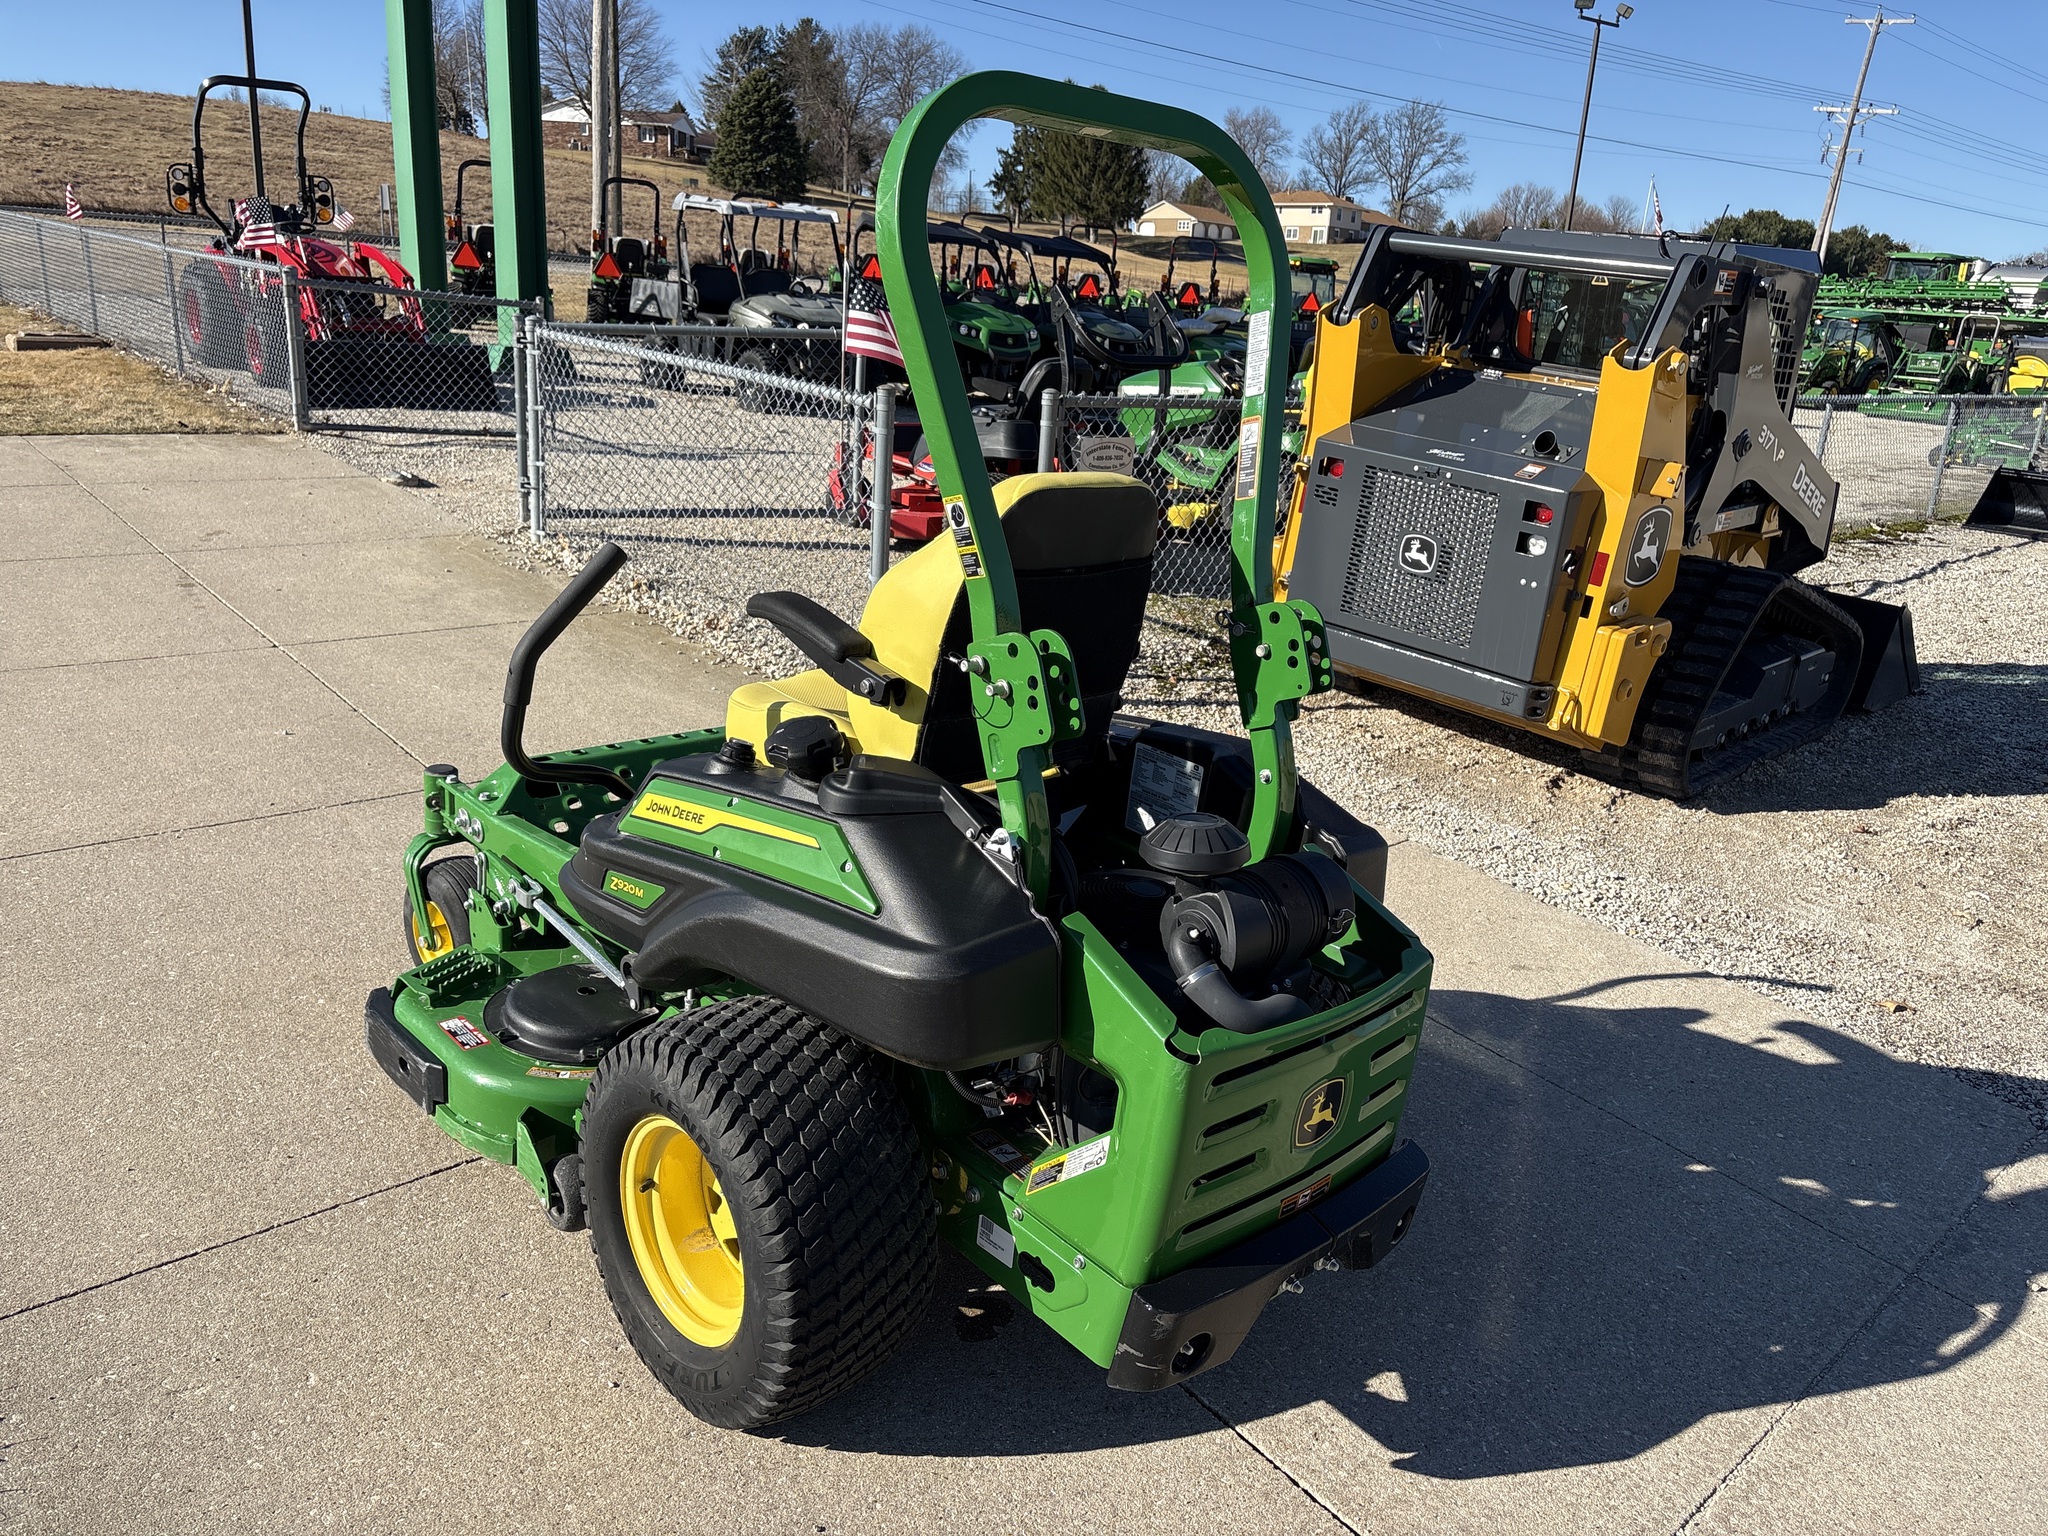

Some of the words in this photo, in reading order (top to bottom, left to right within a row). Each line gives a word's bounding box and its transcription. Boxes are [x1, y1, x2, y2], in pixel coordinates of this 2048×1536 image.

[1086, 444, 1112, 457] Interstate
[1112, 444, 1128, 454] Fence
[1791, 462, 1827, 519] DEERE
[645, 799, 672, 816] JOHN
[671, 806, 706, 825] DEERE
[609, 876, 645, 899] Z920M
[649, 1087, 724, 1179] KENDA
[662, 1361, 724, 1392] TURF
